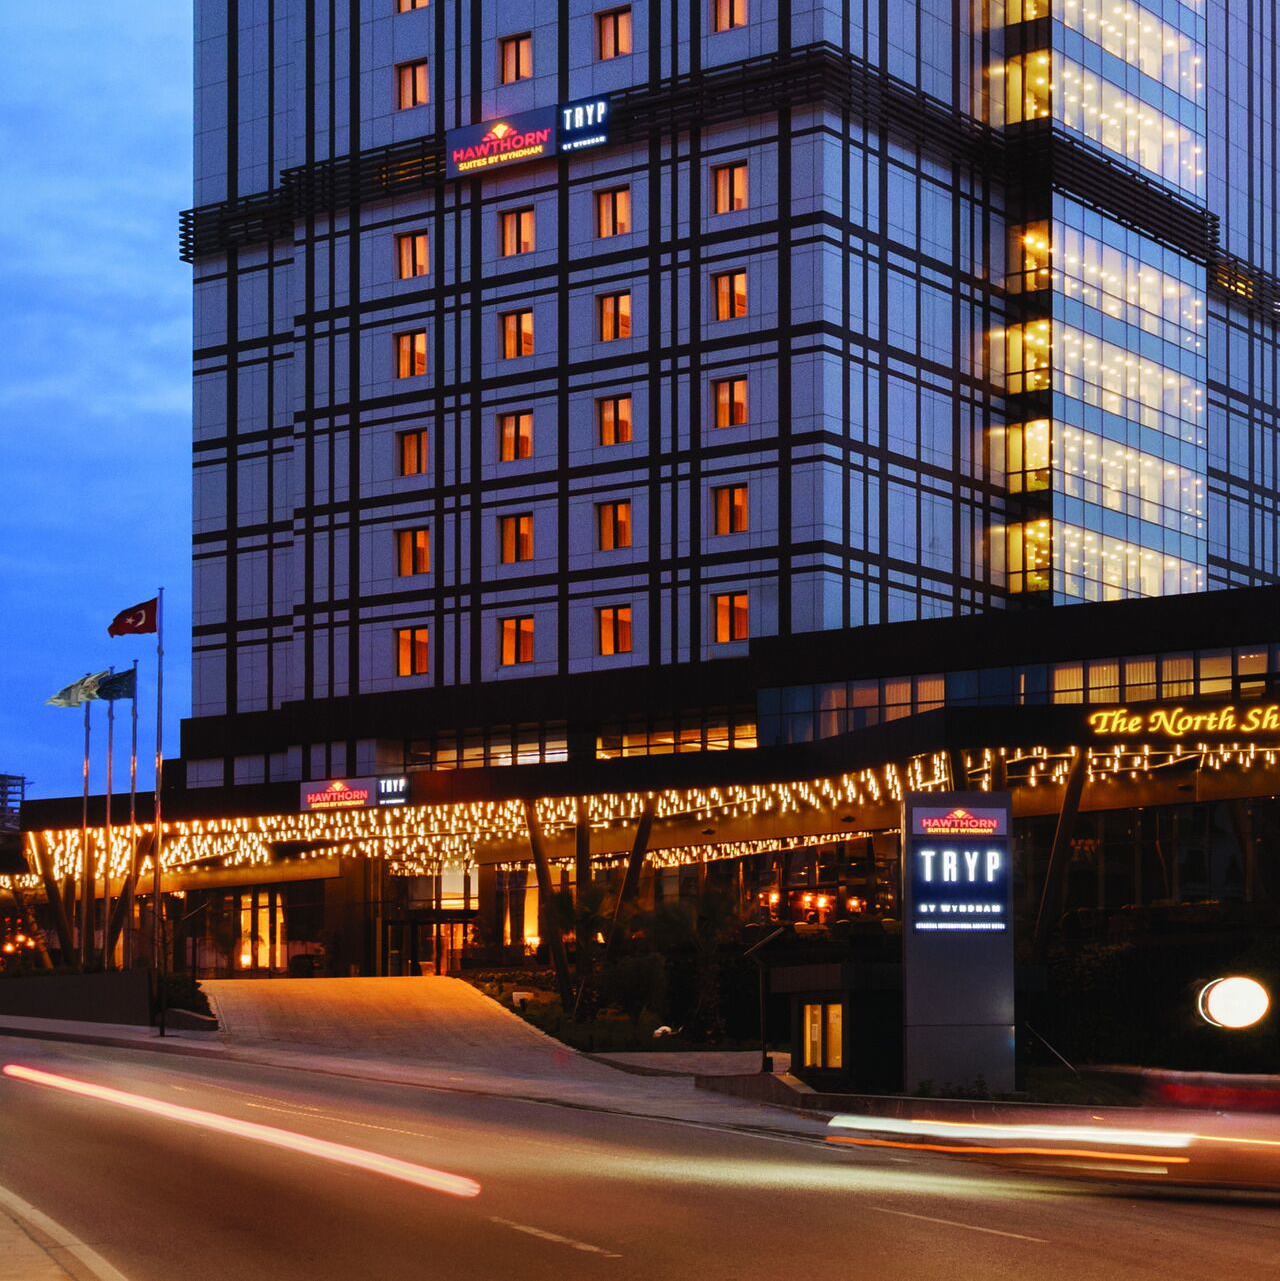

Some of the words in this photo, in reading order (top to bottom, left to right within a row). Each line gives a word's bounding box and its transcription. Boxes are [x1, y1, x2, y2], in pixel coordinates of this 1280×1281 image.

[563, 102, 606, 130] TRYP
[453, 129, 550, 163] HAWTHORN
[458, 157, 488, 171] SUITES
[488, 155, 500, 166] BY
[499, 145, 544, 163] WYNDHAM
[1089, 708, 1143, 735] The
[1148, 705, 1237, 736] North
[307, 790, 368, 803] HAWTHORN
[922, 818, 998, 828] HAWTHORN
[920, 850, 1001, 882] TRYP
[920, 904, 936, 913] BY
[940, 904, 1001, 913] WYNDHAM
